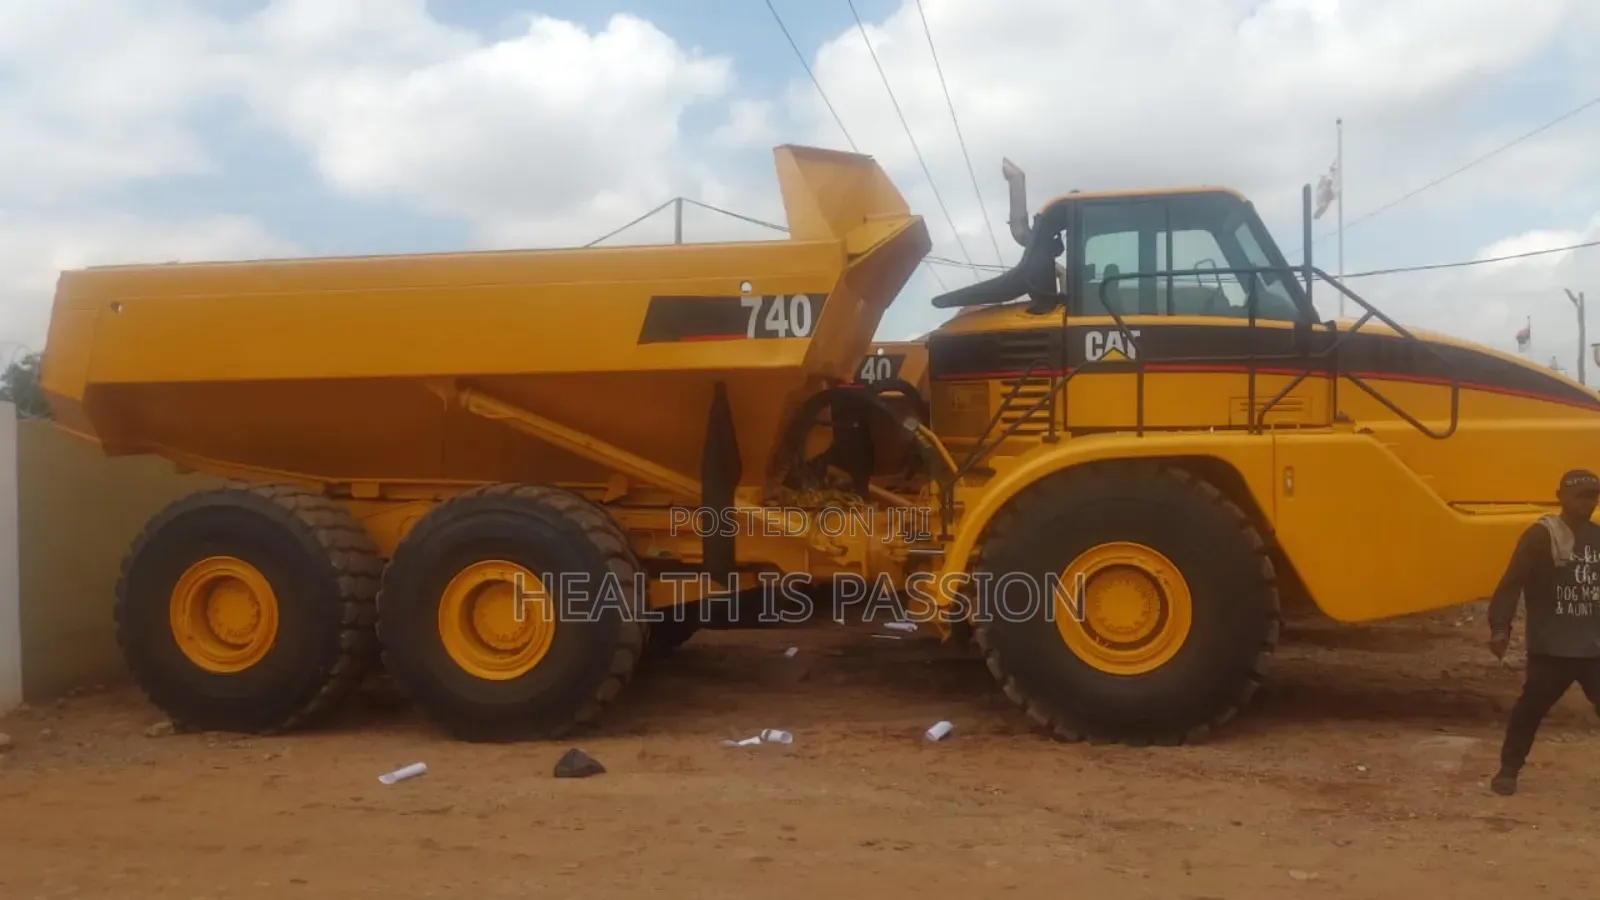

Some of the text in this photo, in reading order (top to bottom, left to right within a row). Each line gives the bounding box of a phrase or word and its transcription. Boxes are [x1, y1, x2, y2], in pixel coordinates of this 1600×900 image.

[740, 295, 812, 338] 740
[1085, 330, 1141, 361] CAT
[860, 356, 891, 384] 40
[1572, 564, 1600, 585] the
[1556, 585, 1578, 601] DOG
[1568, 602, 1593, 616] AUNT
